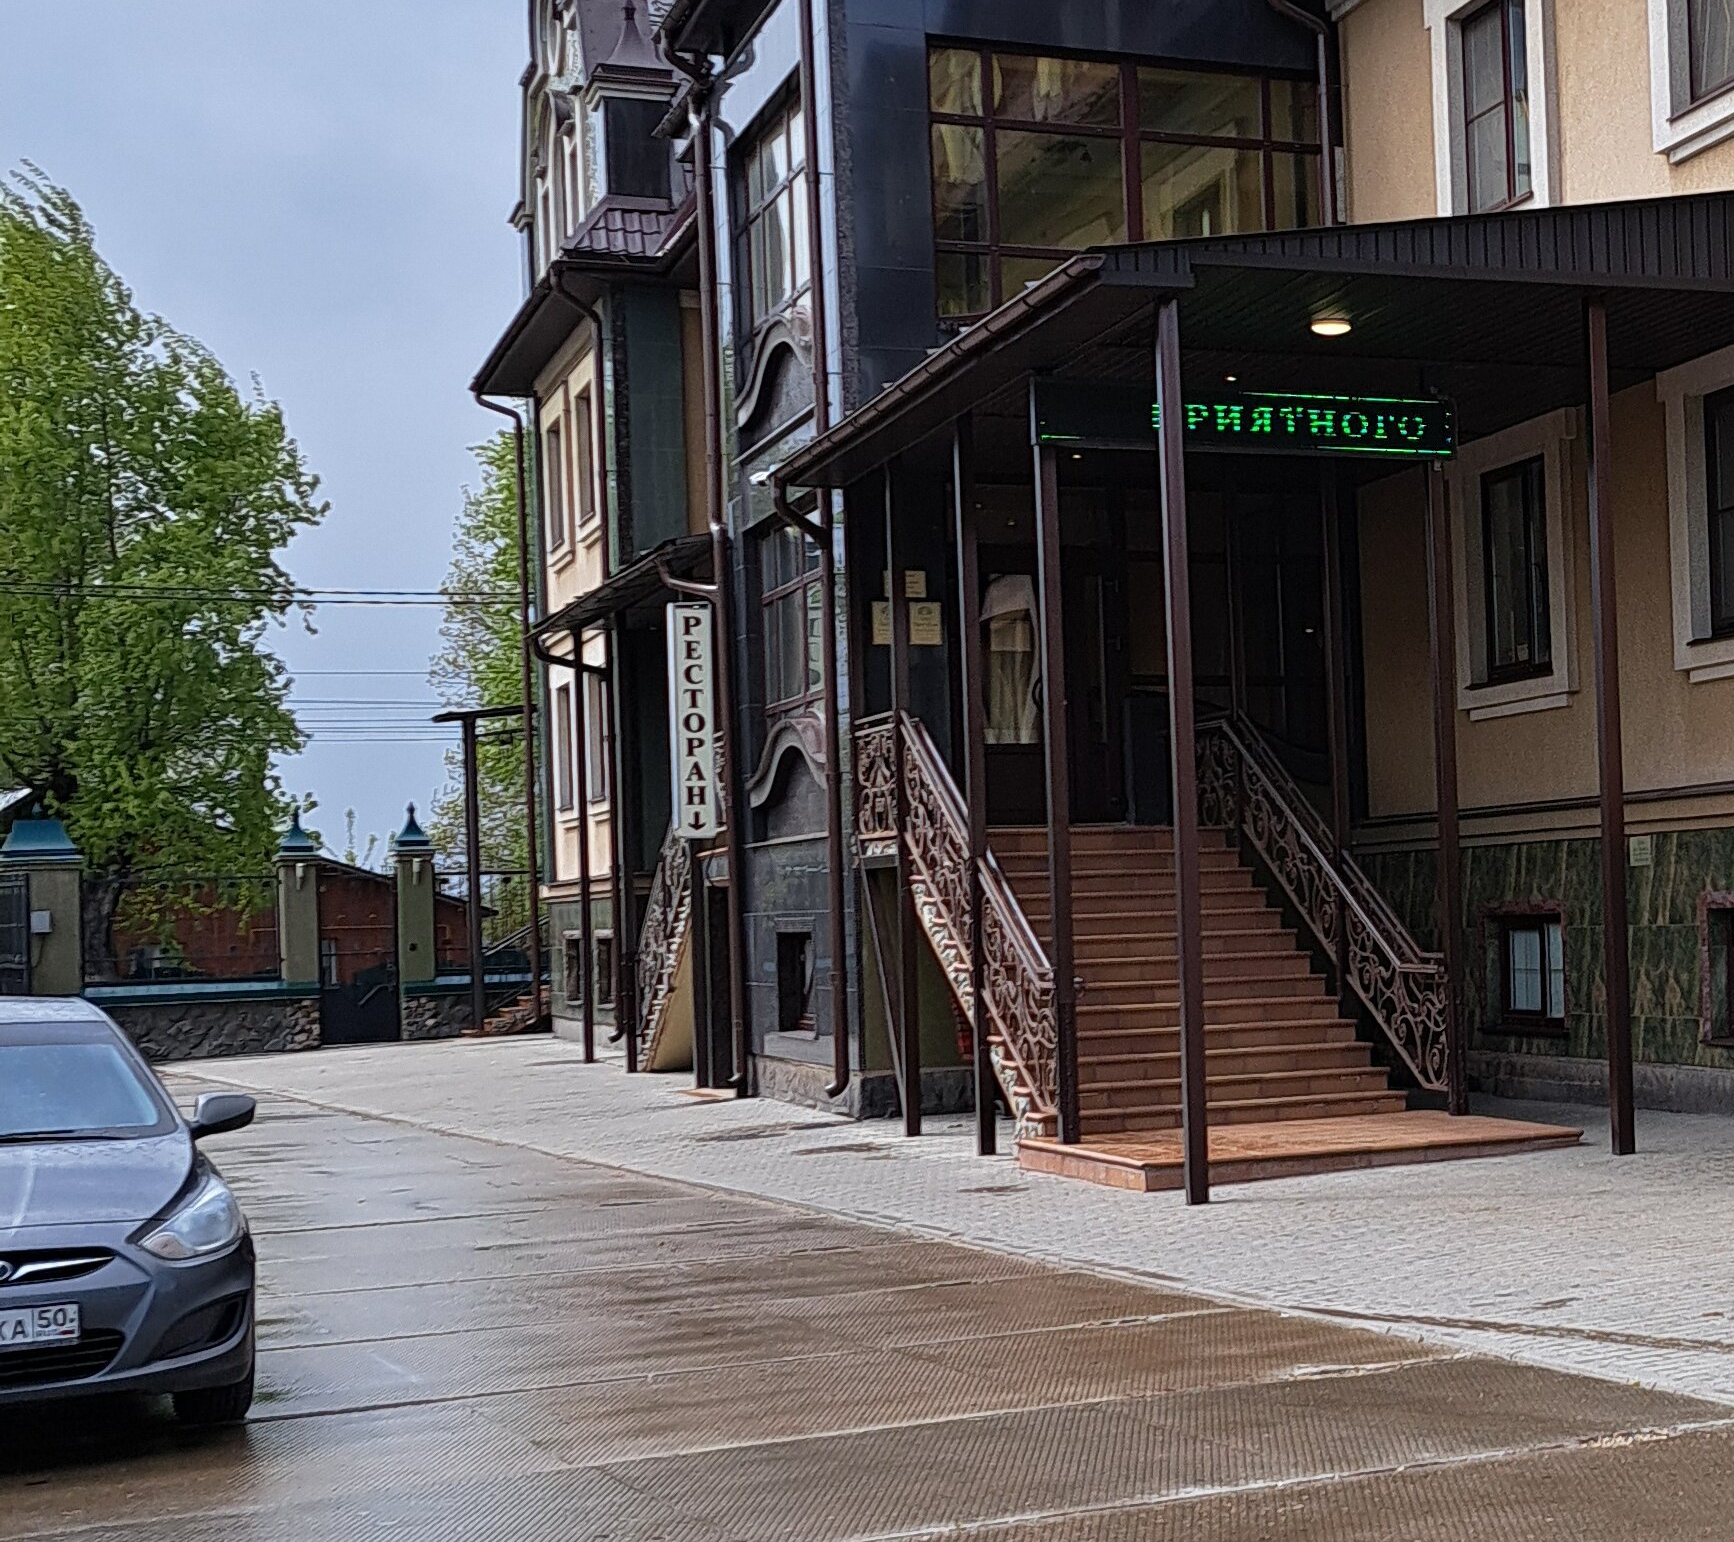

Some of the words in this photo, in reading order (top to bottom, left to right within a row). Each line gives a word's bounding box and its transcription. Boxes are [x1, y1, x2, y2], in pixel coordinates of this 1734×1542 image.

[1152, 404, 1427, 440] РИЯТНОГО
[682, 615, 708, 806] РЕСТОРАН
[37, 1307, 67, 1329] 50
